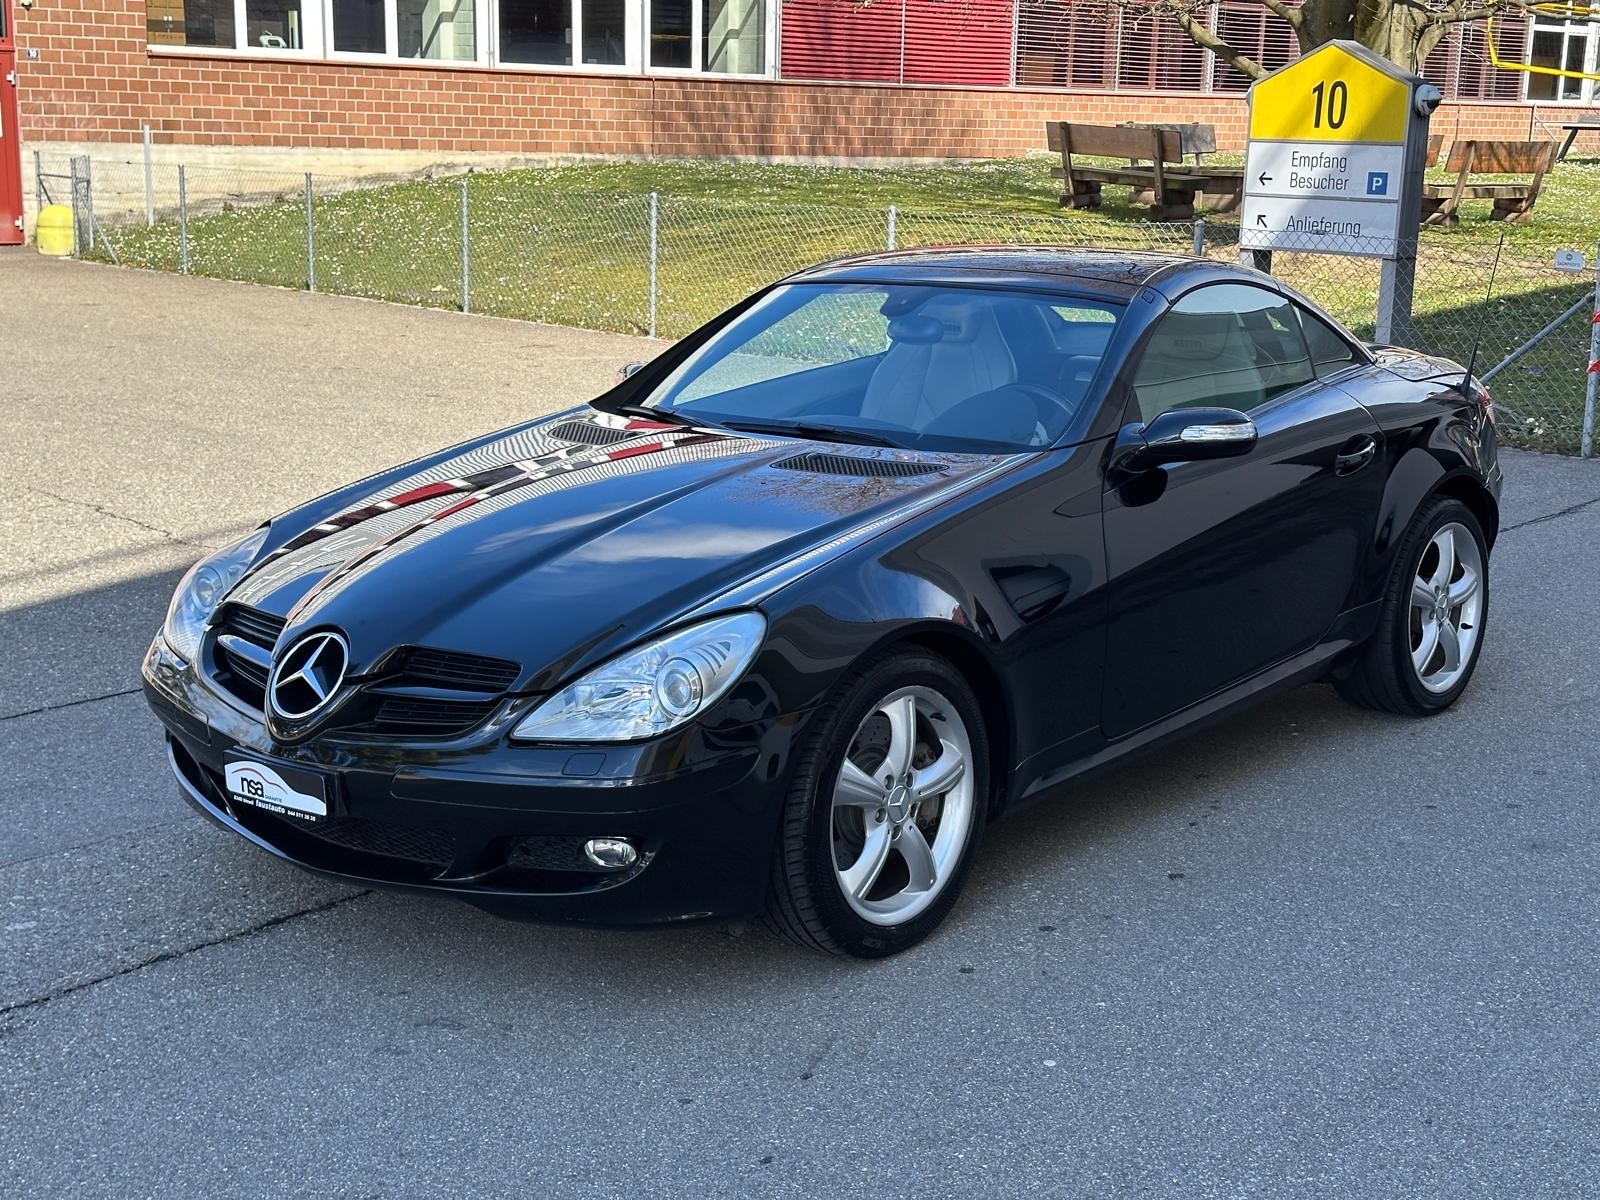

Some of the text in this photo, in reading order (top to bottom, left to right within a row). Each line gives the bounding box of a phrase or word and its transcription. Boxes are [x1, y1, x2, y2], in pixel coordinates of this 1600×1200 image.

[1311, 80, 1348, 130] 10
[1291, 151, 1347, 172] Empfang
[1289, 172, 1350, 191] Besucher
[1372, 177, 1383, 191] P
[1286, 215, 1361, 238] Anlieferung
[240, 776, 265, 798] nsa
[255, 799, 286, 814] faustauto
